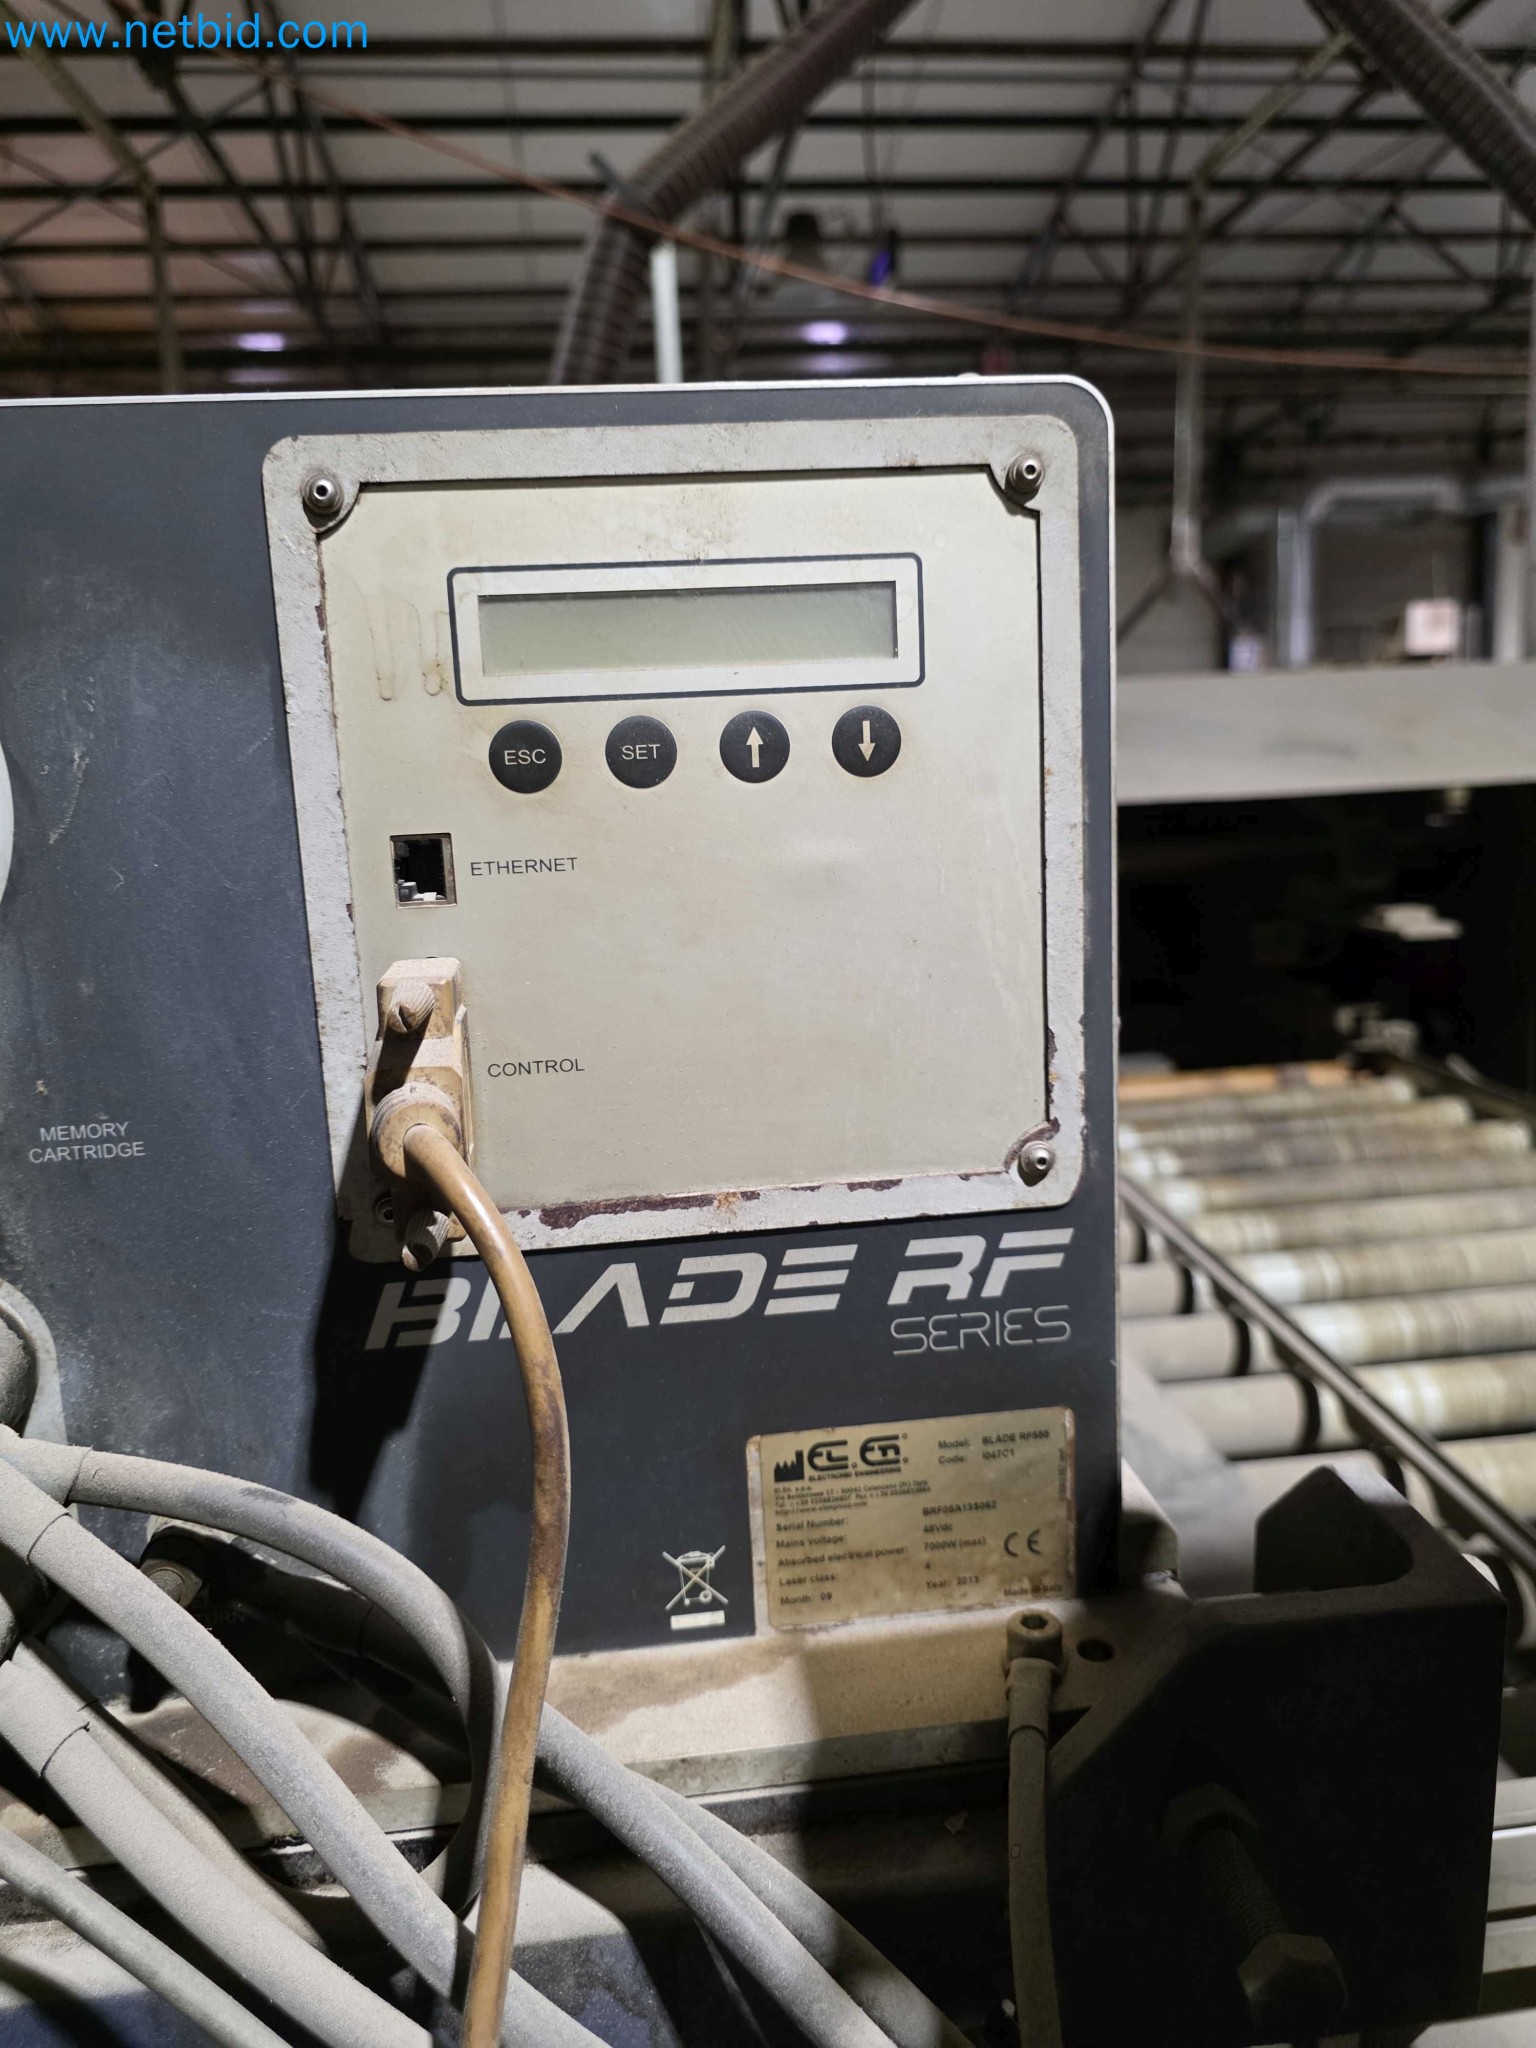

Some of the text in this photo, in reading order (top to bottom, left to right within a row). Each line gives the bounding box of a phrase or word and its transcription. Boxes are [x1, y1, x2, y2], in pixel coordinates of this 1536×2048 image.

[504, 748, 547, 766] ESC
[621, 743, 661, 761] SET
[470, 857, 578, 876] ETHERNET
[487, 1058, 585, 1078] CONTROL
[39, 1121, 129, 1142] MEMORY
[28, 1141, 147, 1164] CARTRIDGE
[887, 1228, 1074, 1305] RF
[890, 1304, 1072, 1355] SERIES
[938, 1438, 970, 1449] Model:
[982, 1432, 1016, 1445] BLADE
[938, 1454, 967, 1465] Code:
[808, 1467, 902, 1482] ELECTRONIC ENGINEERING
[776, 1520, 805, 1532] Serial
[806, 1517, 848, 1529] Number:
[776, 1538, 805, 1549] Mains
[778, 1554, 825, 1567] Absorbed
[827, 1549, 873, 1562] electrical
[780, 1576, 807, 1586] Laser
